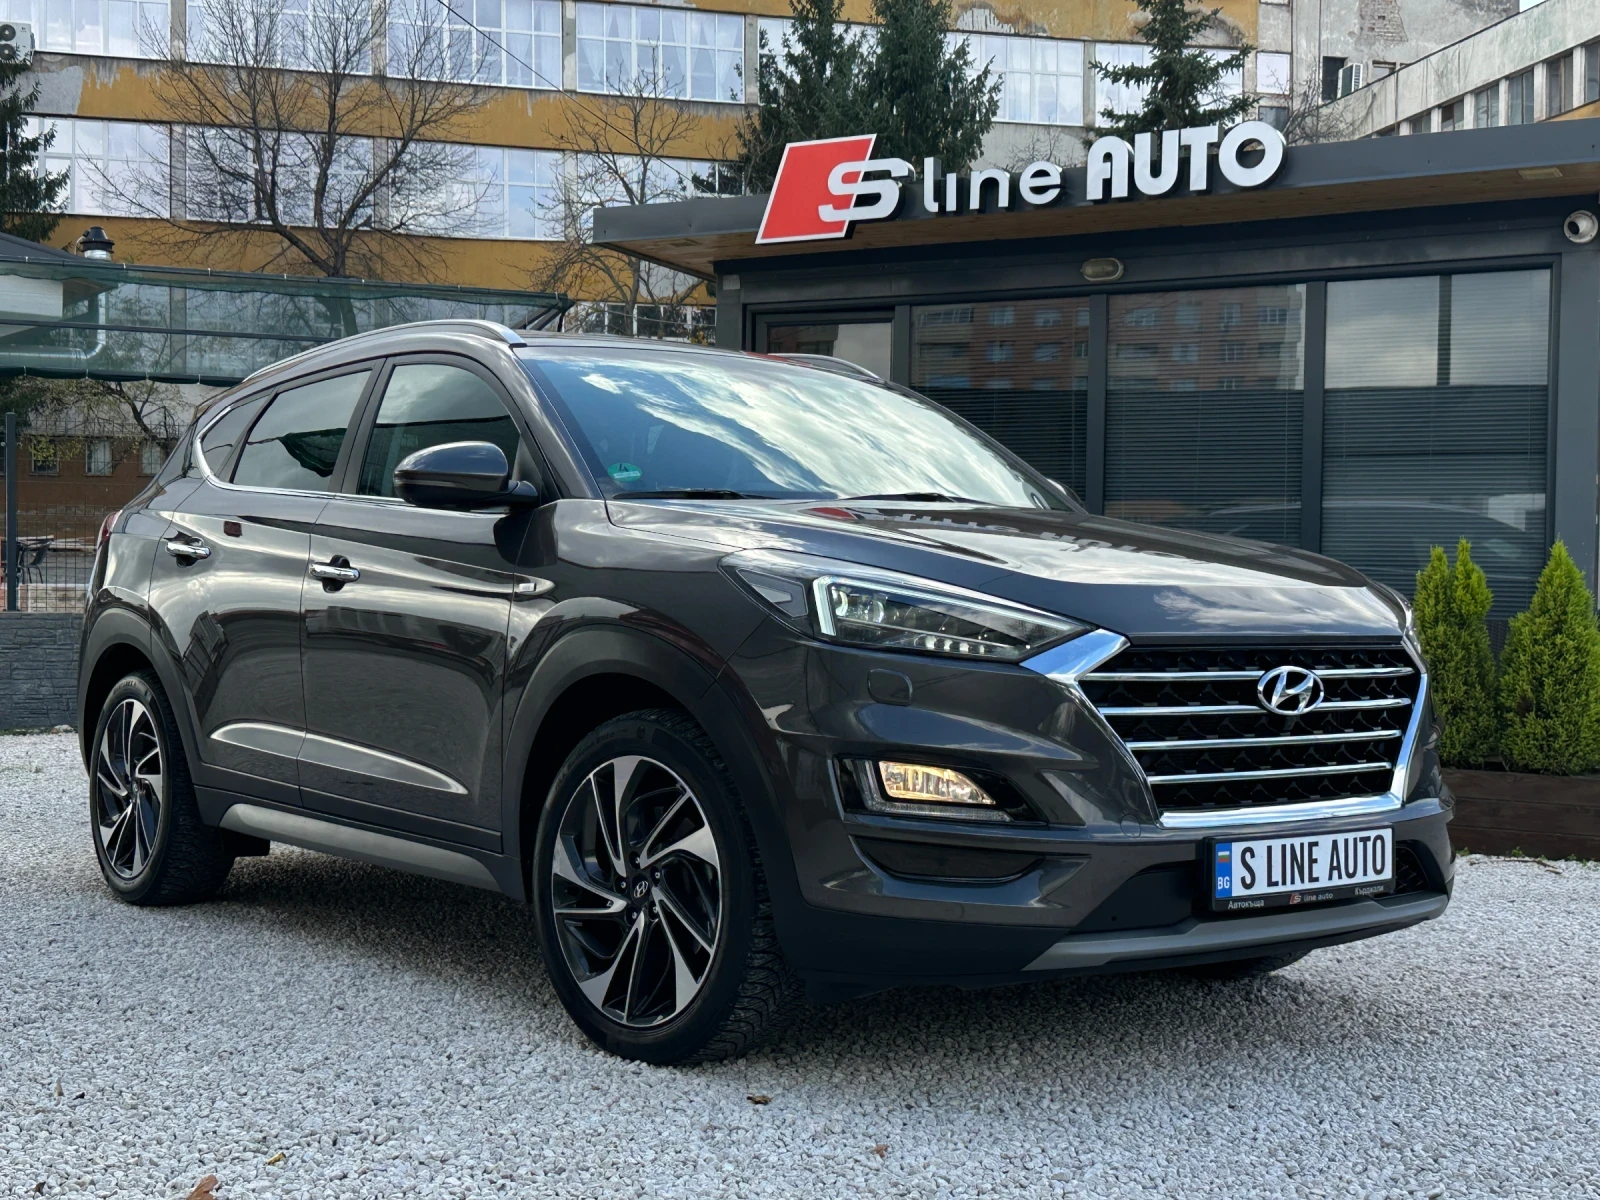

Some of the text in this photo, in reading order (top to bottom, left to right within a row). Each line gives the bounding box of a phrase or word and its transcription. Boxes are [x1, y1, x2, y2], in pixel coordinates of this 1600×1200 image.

[818, 120, 1286, 222] S line AUTO
[1240, 834, 1386, 890] S LINE AUTO
[1217, 876, 1230, 889] BG
[1303, 893, 1317, 902] line
[1317, 892, 1334, 901] auto
[1227, 899, 1265, 910] Автокъща
